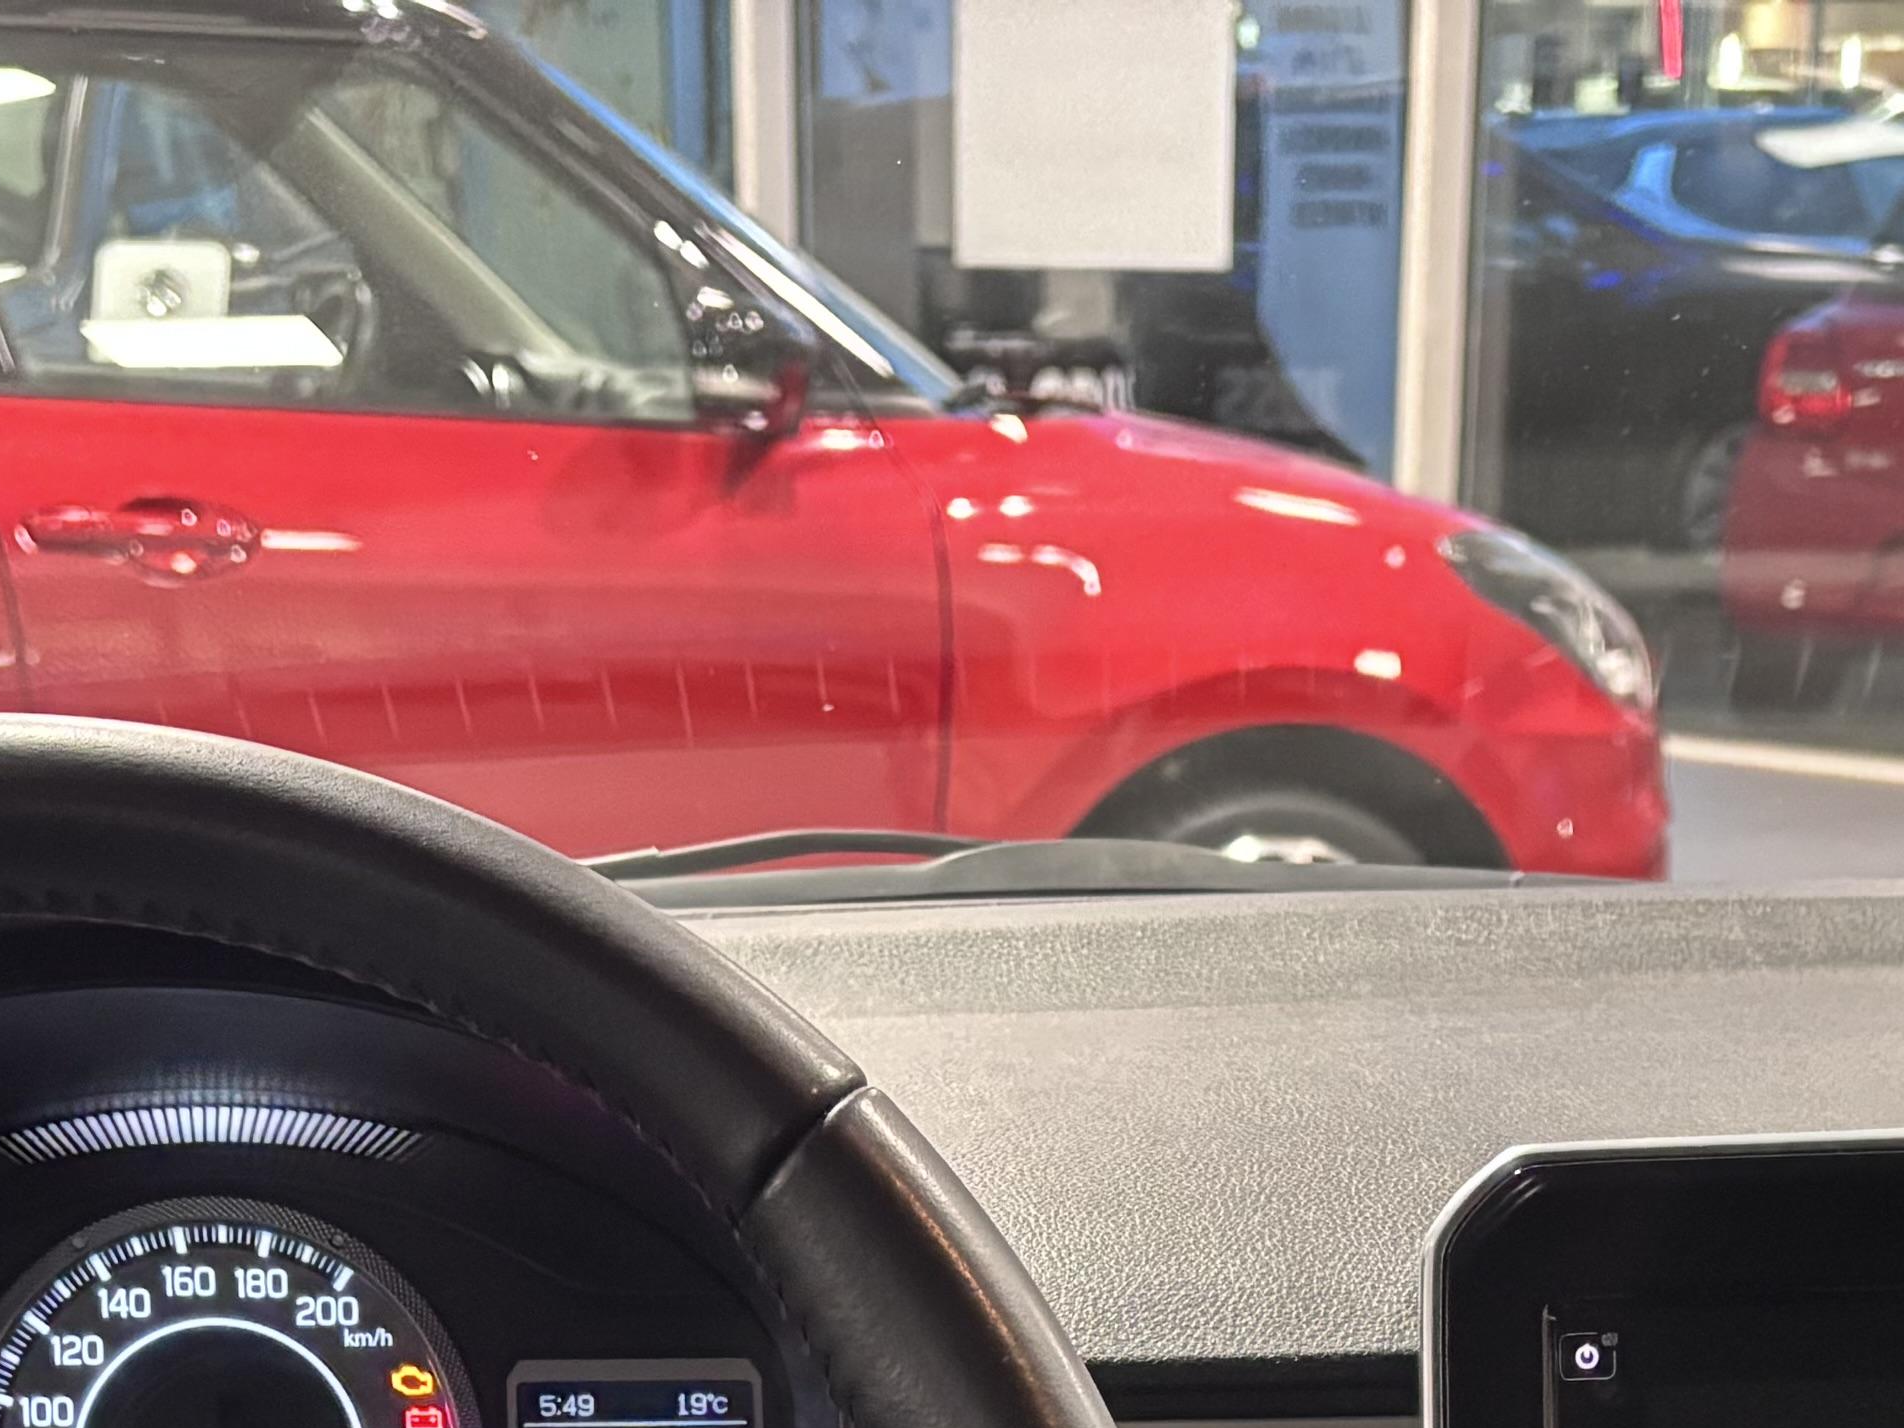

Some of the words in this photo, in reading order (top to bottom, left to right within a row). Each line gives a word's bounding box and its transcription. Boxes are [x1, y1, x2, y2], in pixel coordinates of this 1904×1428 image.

[161, 1265, 217, 1298] 160
[234, 1267, 289, 1300] 180
[97, 1287, 152, 1319] 140
[295, 1295, 360, 1327] 200
[49, 1334, 105, 1366] 120
[342, 1327, 394, 1348] km/h
[18, 1395, 75, 1428] 100
[539, 1393, 595, 1418] 5:49
